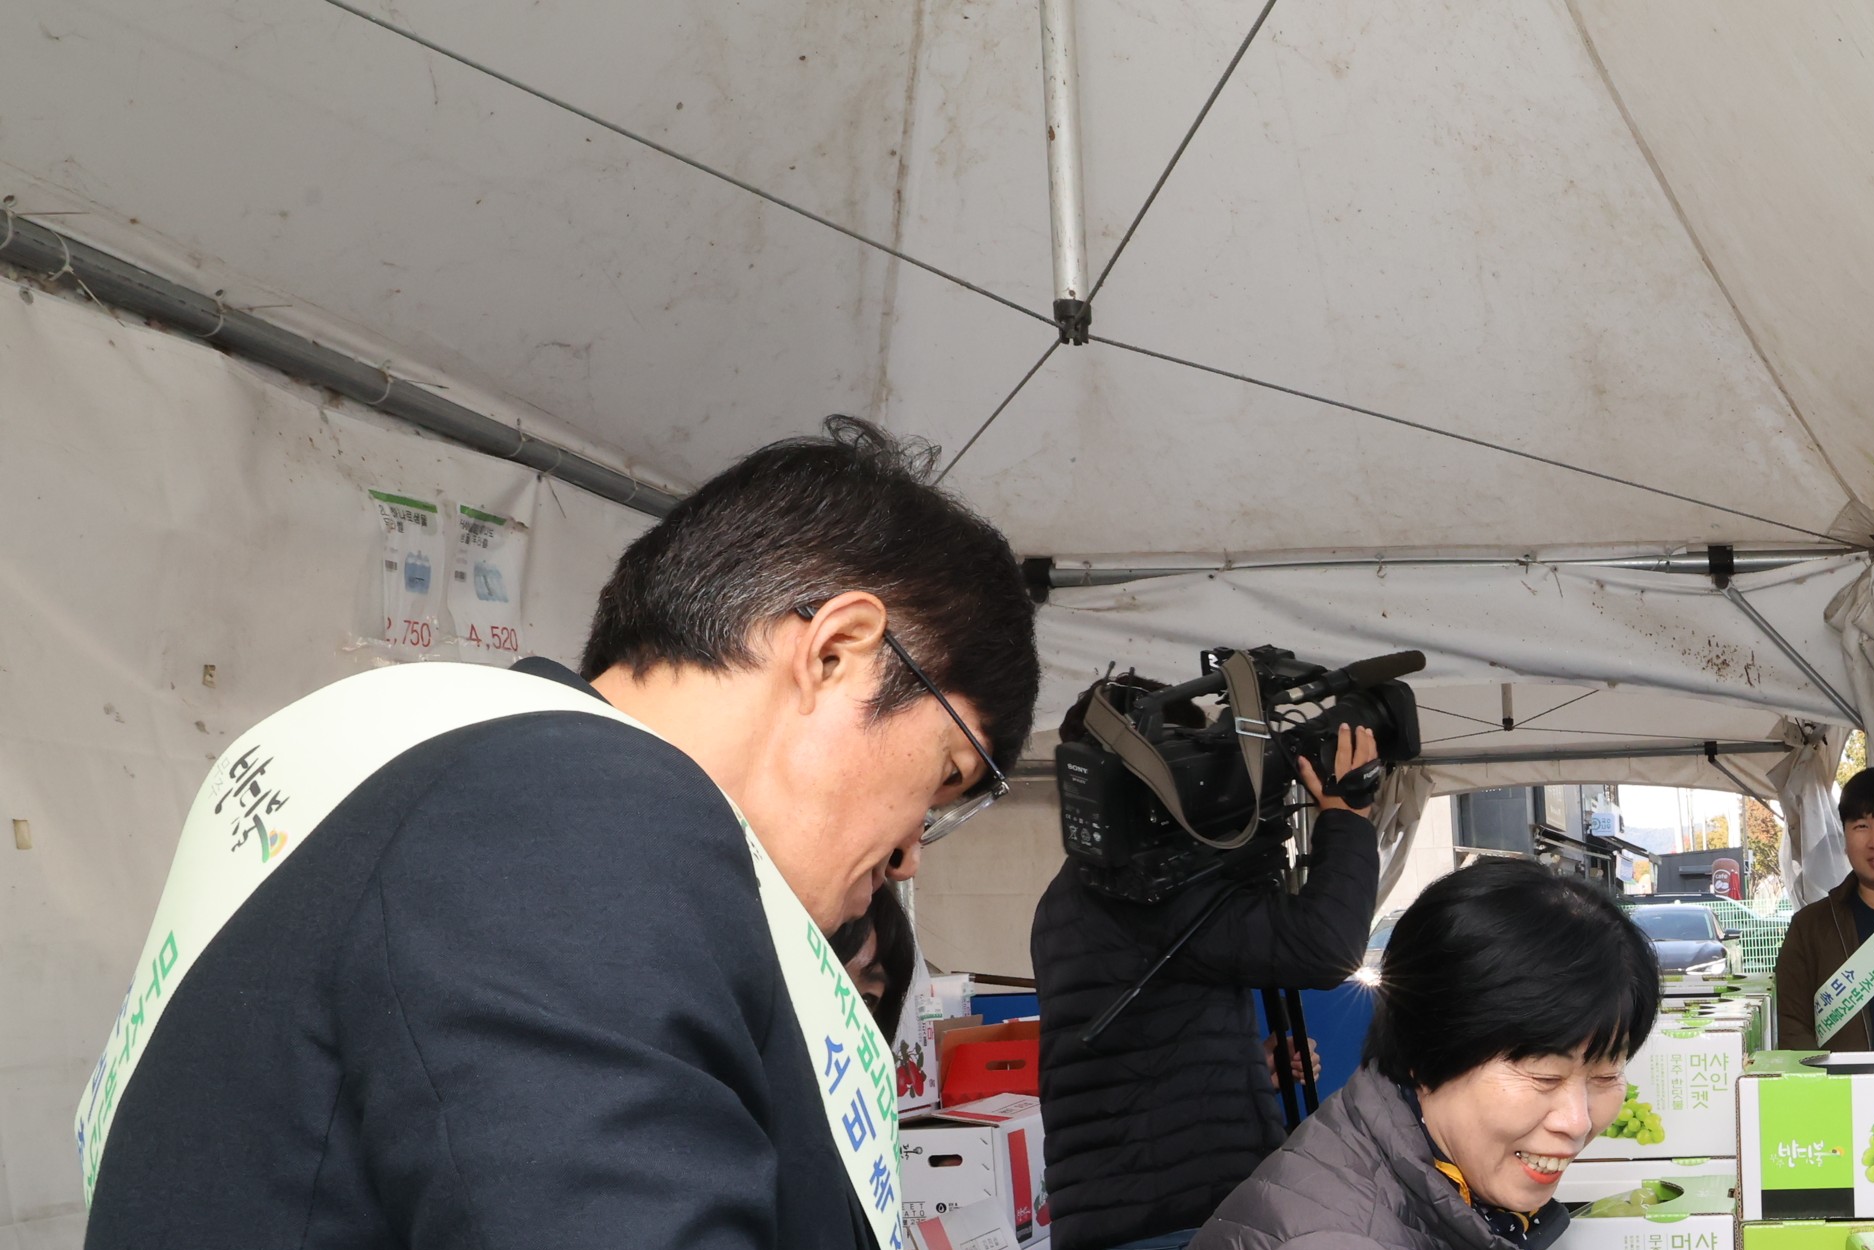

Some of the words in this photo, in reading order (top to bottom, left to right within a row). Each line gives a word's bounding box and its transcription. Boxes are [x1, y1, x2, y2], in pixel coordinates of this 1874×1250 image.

[469, 624, 518, 652] 4,520
[1066, 763, 1088, 774] SONY
[1814, 968, 1856, 1016] 소비촉진
[1671, 1054, 1682, 1074] 무주
[1710, 1052, 1729, 1091] 샤인
[1778, 1139, 1826, 1168] 반딧불
